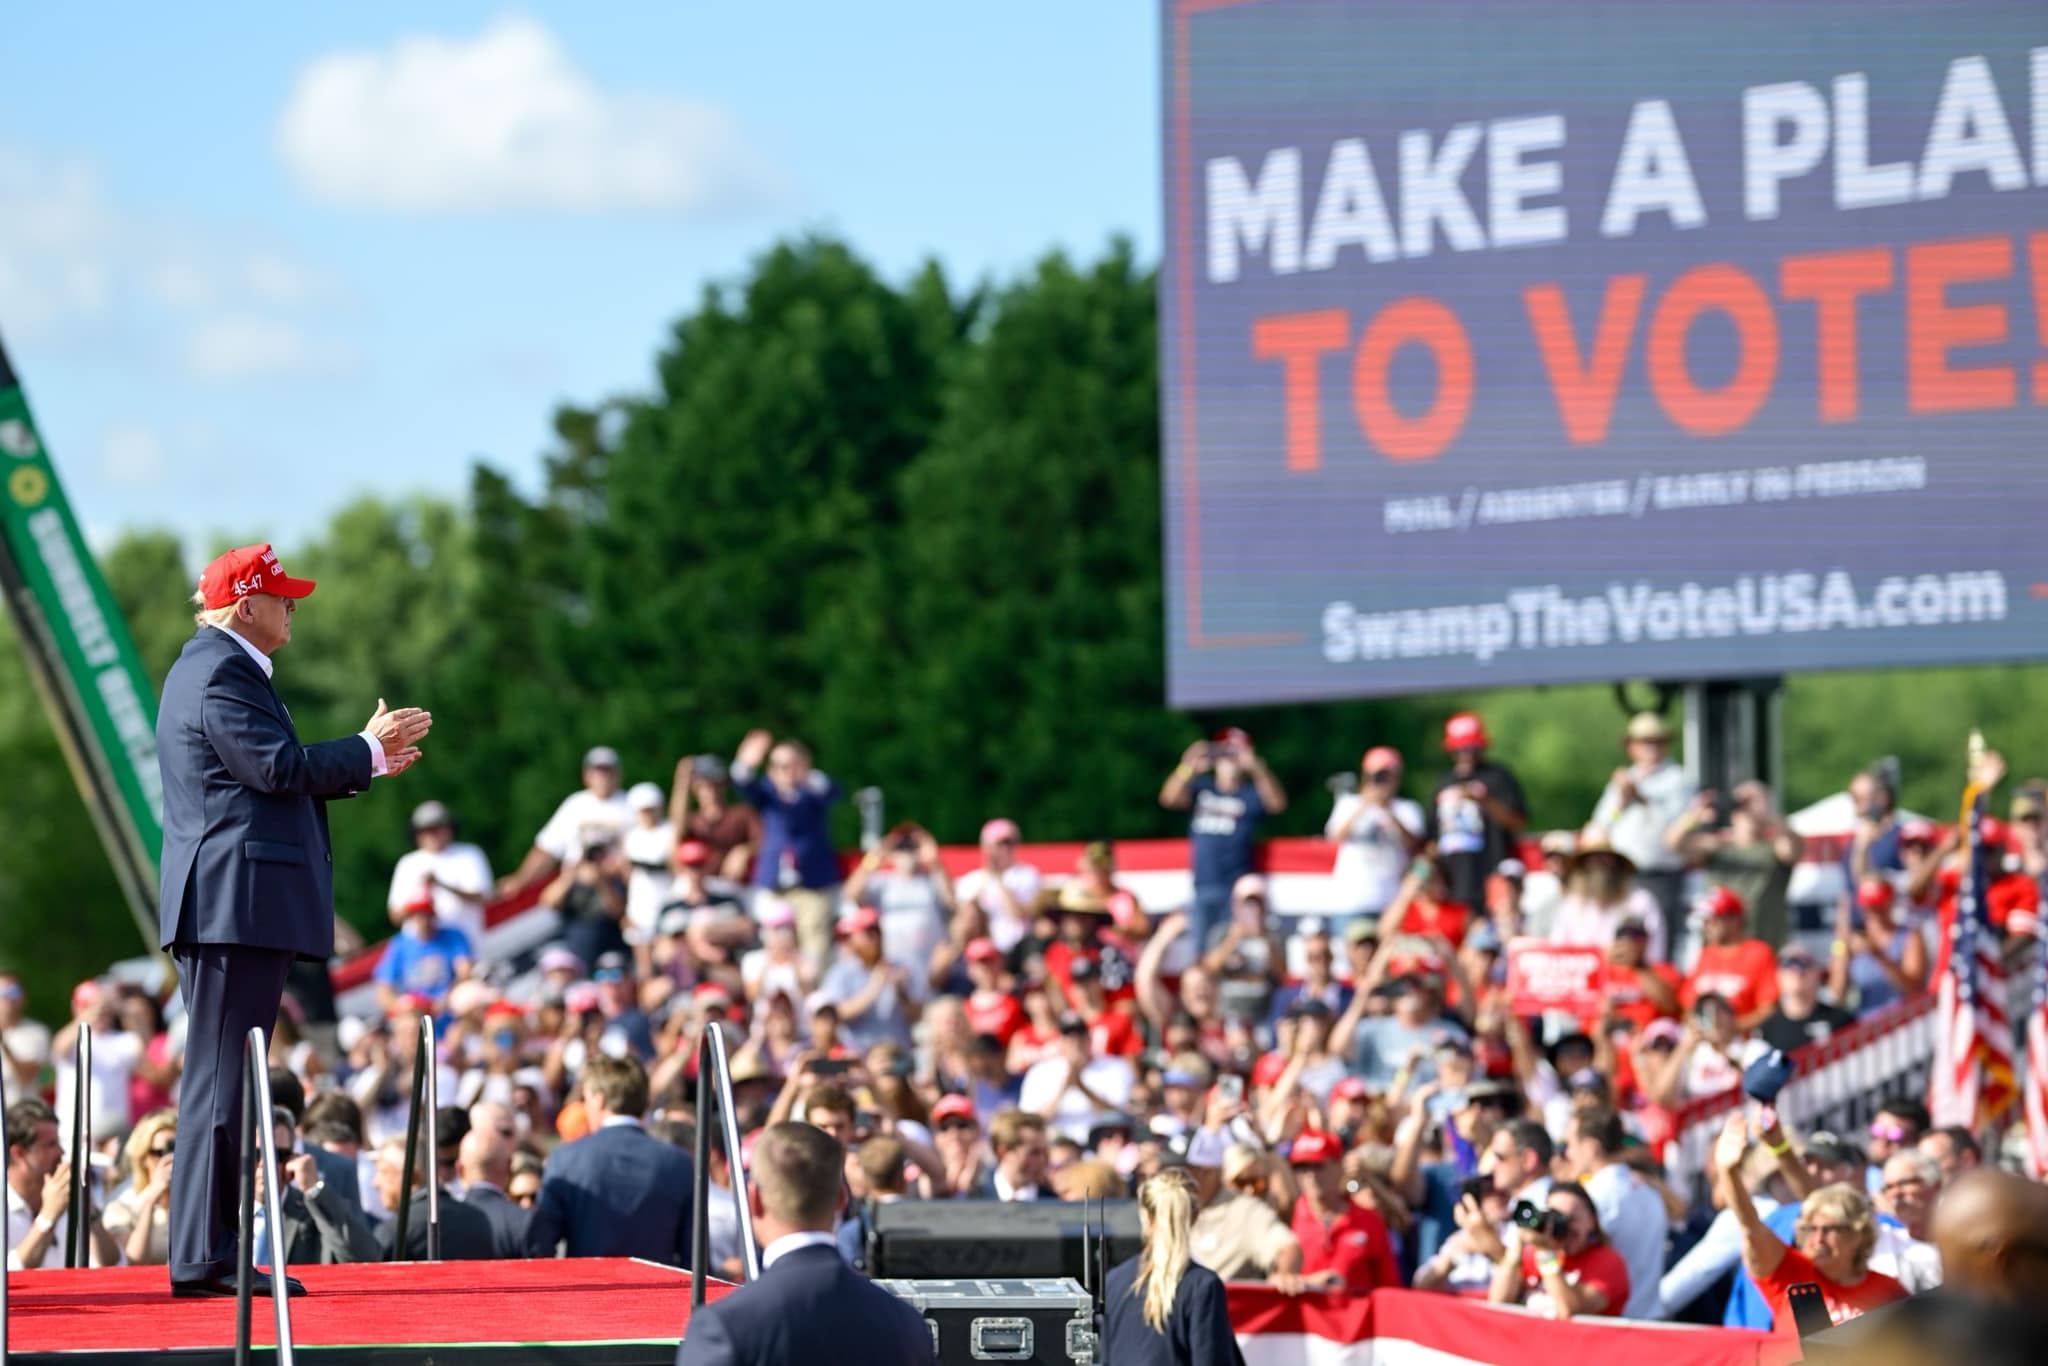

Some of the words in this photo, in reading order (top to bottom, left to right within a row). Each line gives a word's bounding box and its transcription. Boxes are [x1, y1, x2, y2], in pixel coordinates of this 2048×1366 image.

[1206, 114, 1567, 283] MAKE
[1601, 99, 1706, 236] A
[1743, 46, 2048, 220] PLA
[1251, 296, 1475, 473] TO
[233, 574, 262, 594] 45-47
[1321, 570, 2007, 664] SwampTheVoteUSA.com
